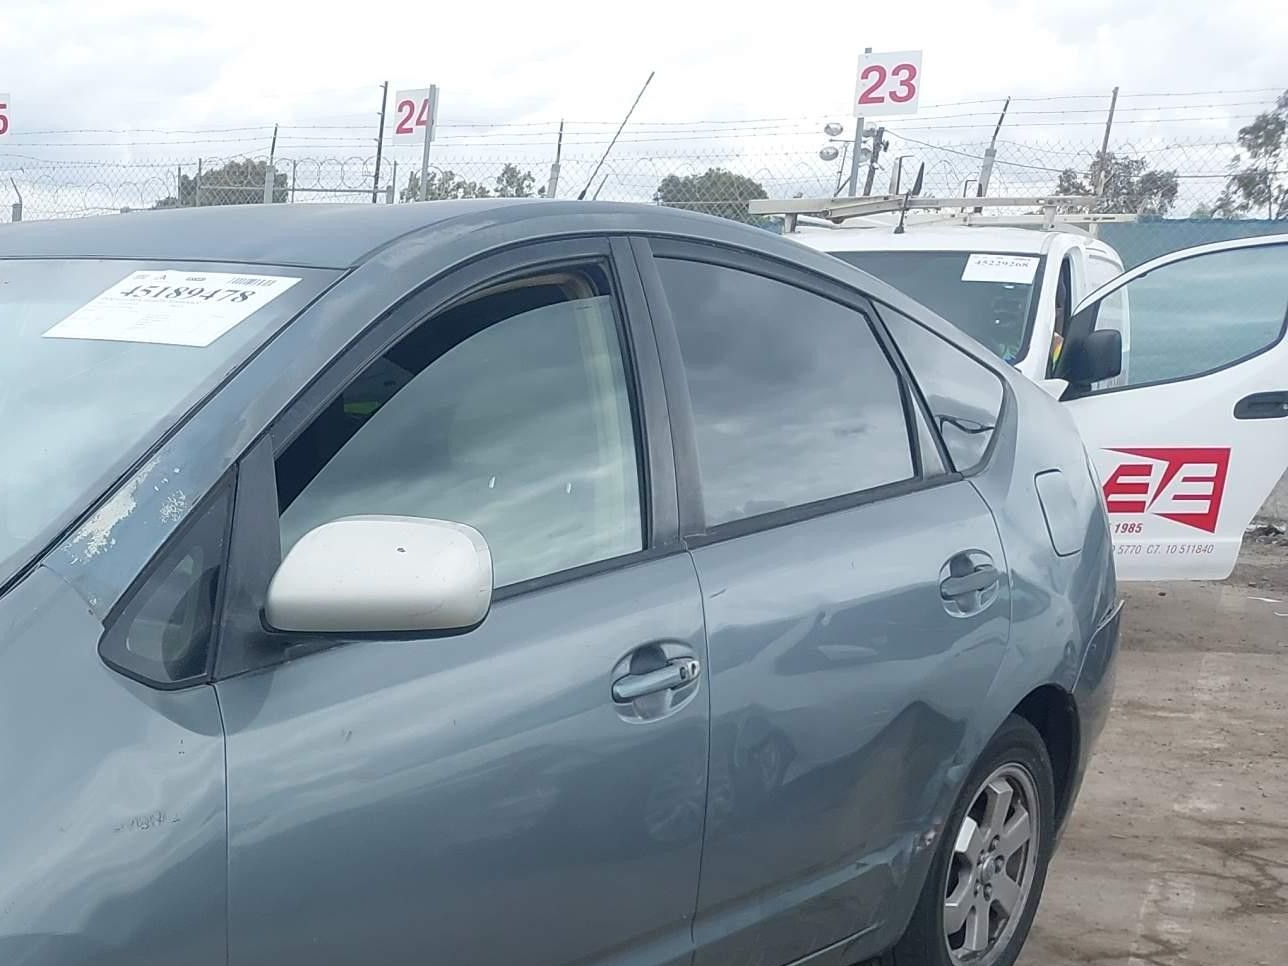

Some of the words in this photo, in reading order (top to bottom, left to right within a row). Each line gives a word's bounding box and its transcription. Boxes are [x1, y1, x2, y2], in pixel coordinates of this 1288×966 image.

[858, 63, 917, 104] 23
[395, 98, 434, 134] 24
[120, 285, 256, 303] 45189478
[1114, 522, 1143, 534] 1985
[1117, 544, 1142, 555] 5770
[1178, 544, 1214, 554] 511840
